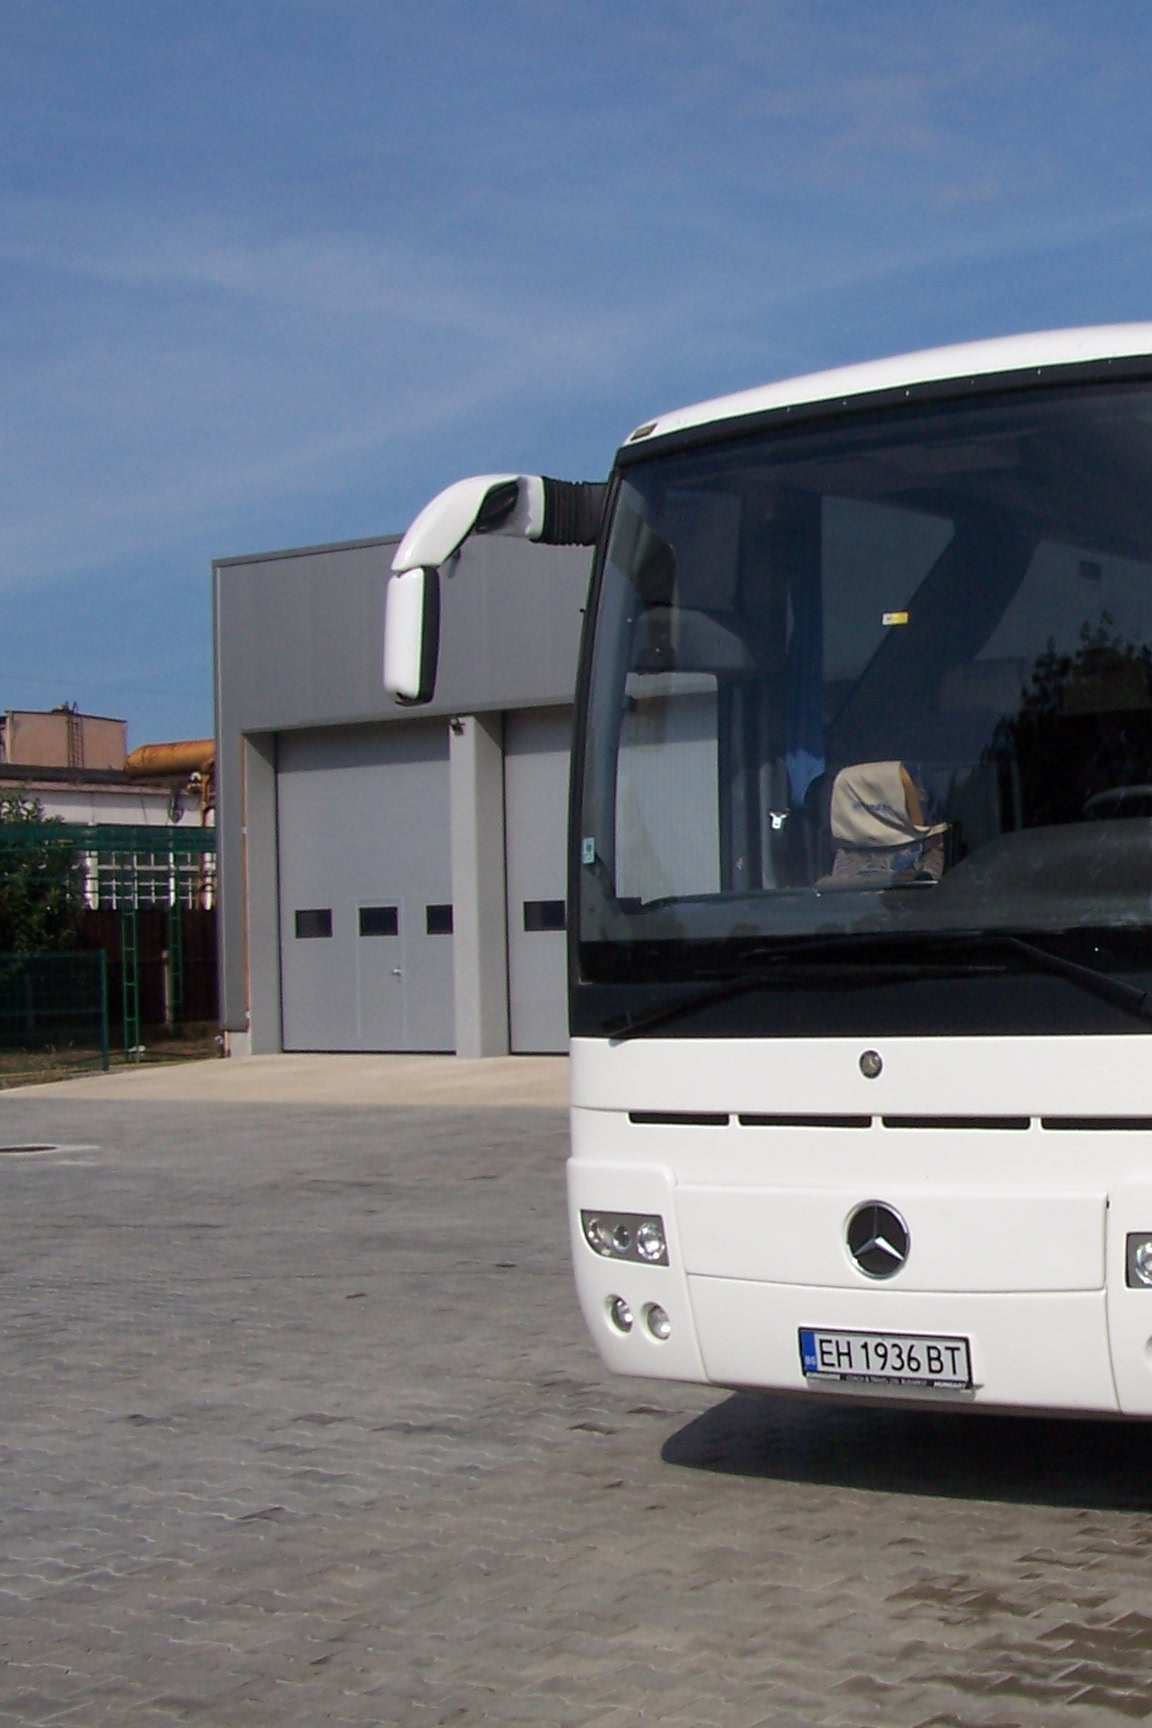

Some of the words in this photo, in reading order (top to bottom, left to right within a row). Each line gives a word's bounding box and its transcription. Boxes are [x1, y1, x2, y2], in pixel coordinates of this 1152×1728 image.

[819, 1338, 853, 1369] EH
[860, 1341, 922, 1372] 1936
[926, 1345, 961, 1375] BT
